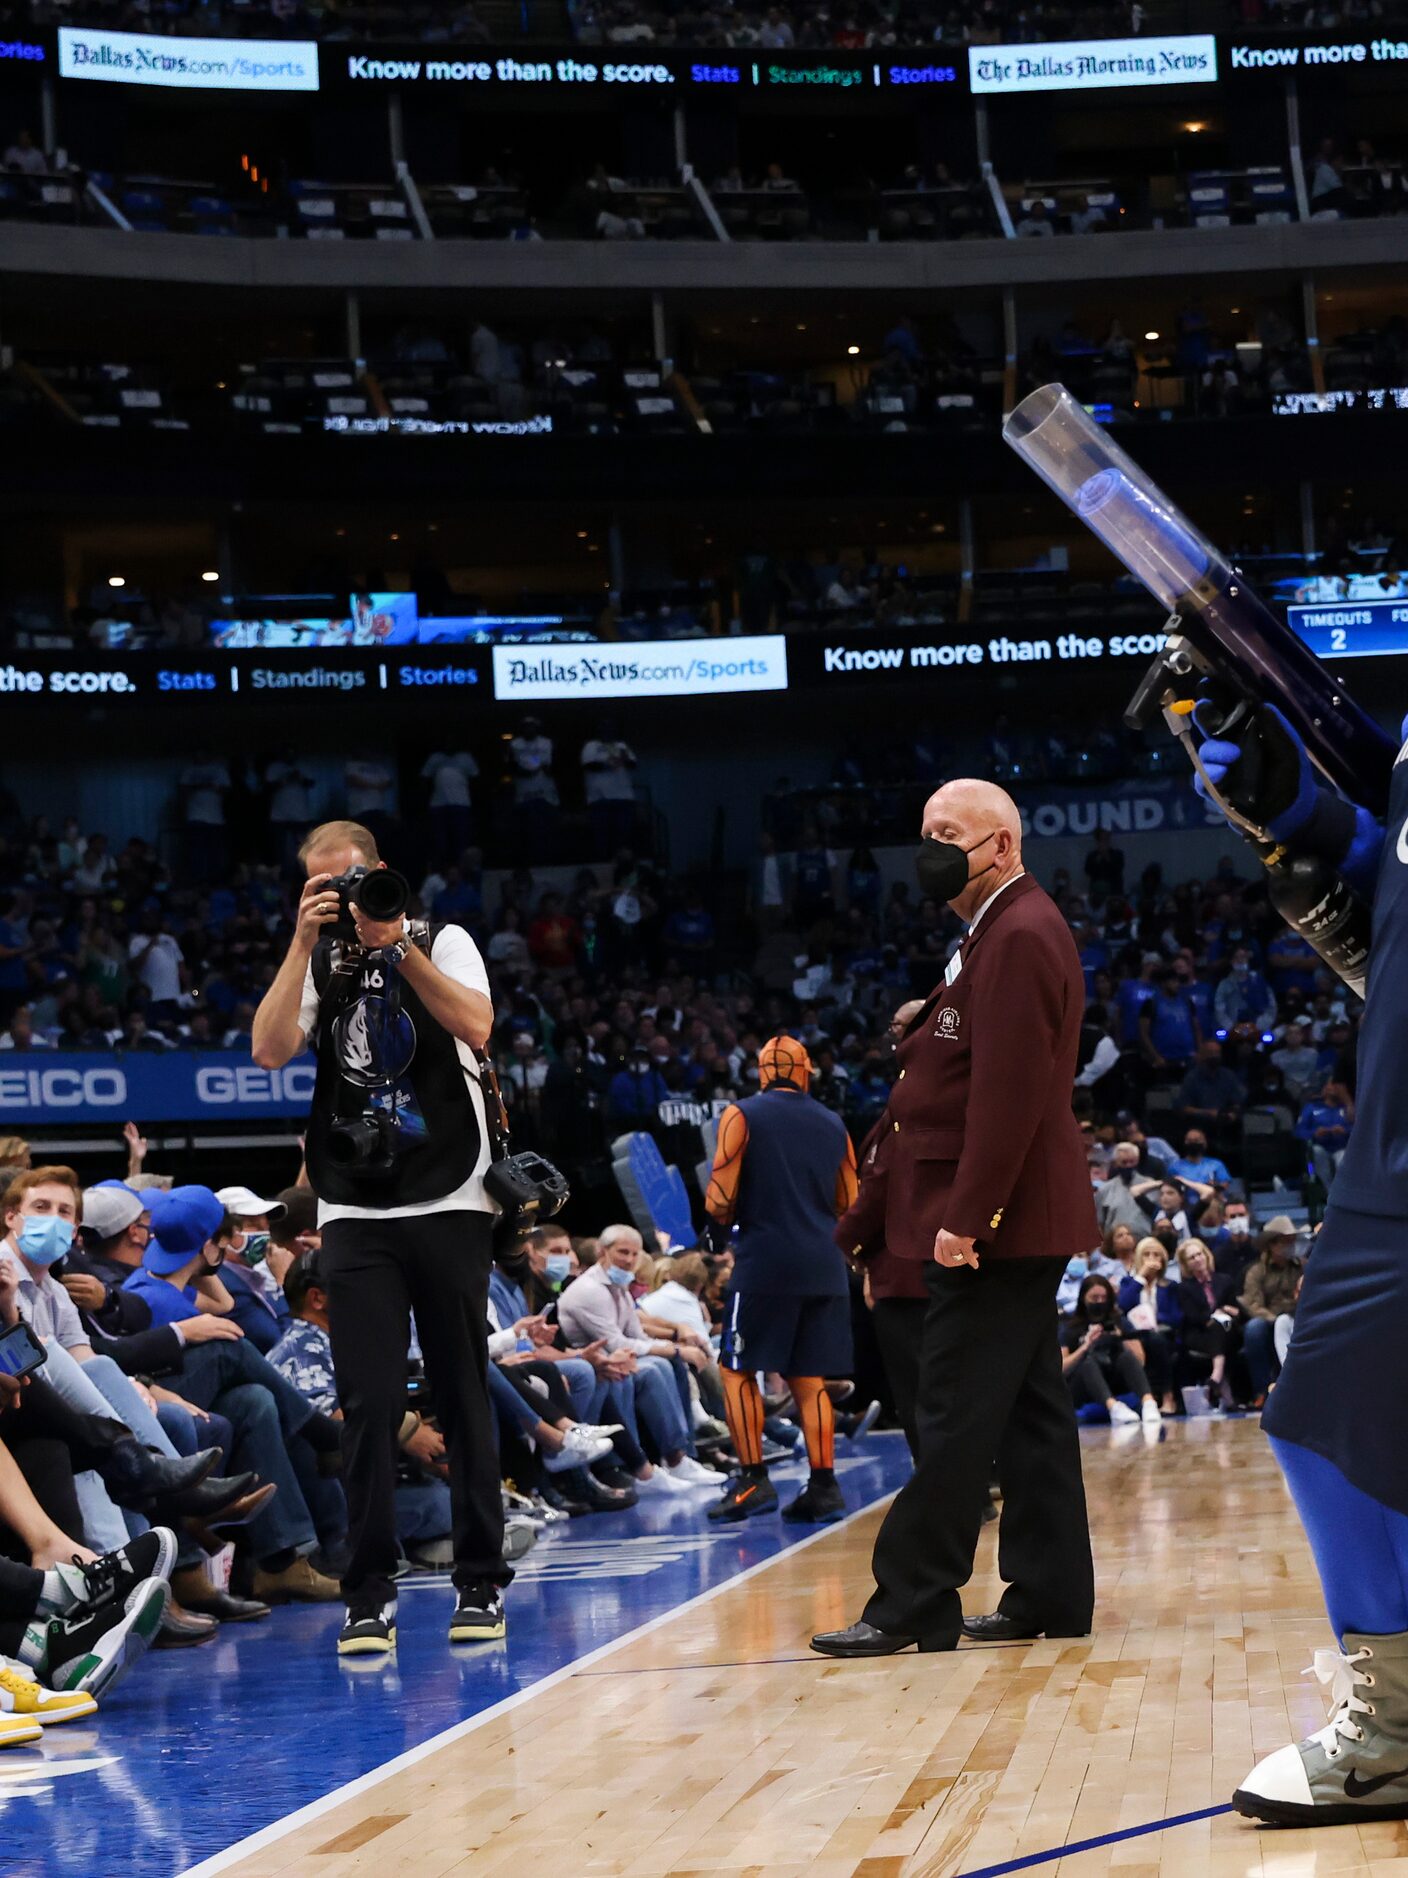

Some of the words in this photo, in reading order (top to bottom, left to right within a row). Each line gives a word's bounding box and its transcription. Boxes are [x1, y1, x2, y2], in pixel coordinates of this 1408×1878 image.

[0, 40, 44, 61] ories
[1231, 46, 1299, 68] Know
[1303, 43, 1367, 64] more
[349, 56, 421, 79] Know
[426, 61, 492, 80] more
[496, 58, 552, 82] than
[556, 59, 598, 82] the
[602, 63, 675, 84] score.
[691, 64, 740, 83] Stats
[768, 65, 862, 86] Standings
[889, 66, 956, 84] Stories
[977, 60, 1011, 83] The
[1017, 57, 1073, 80] Dallas
[1076, 55, 1155, 80] Morning
[1159, 52, 1208, 74] News
[1302, 610, 1373, 627] TIMEOUTS
[824, 647, 904, 672] Know
[910, 643, 983, 667] more
[989, 637, 1051, 663] than
[1056, 633, 1103, 659] the
[1109, 634, 1168, 656] scor
[1331, 628, 1347, 650] 2
[0, 664, 44, 692] the
[49, 671, 136, 692] score.
[157, 669, 216, 691] Stats
[251, 667, 366, 690] Standings
[400, 665, 478, 686] Stories
[508, 657, 768, 686] DallasNews.com/Sports
[0, 1068, 127, 1107] EICO
[196, 1066, 316, 1104] GEIC
